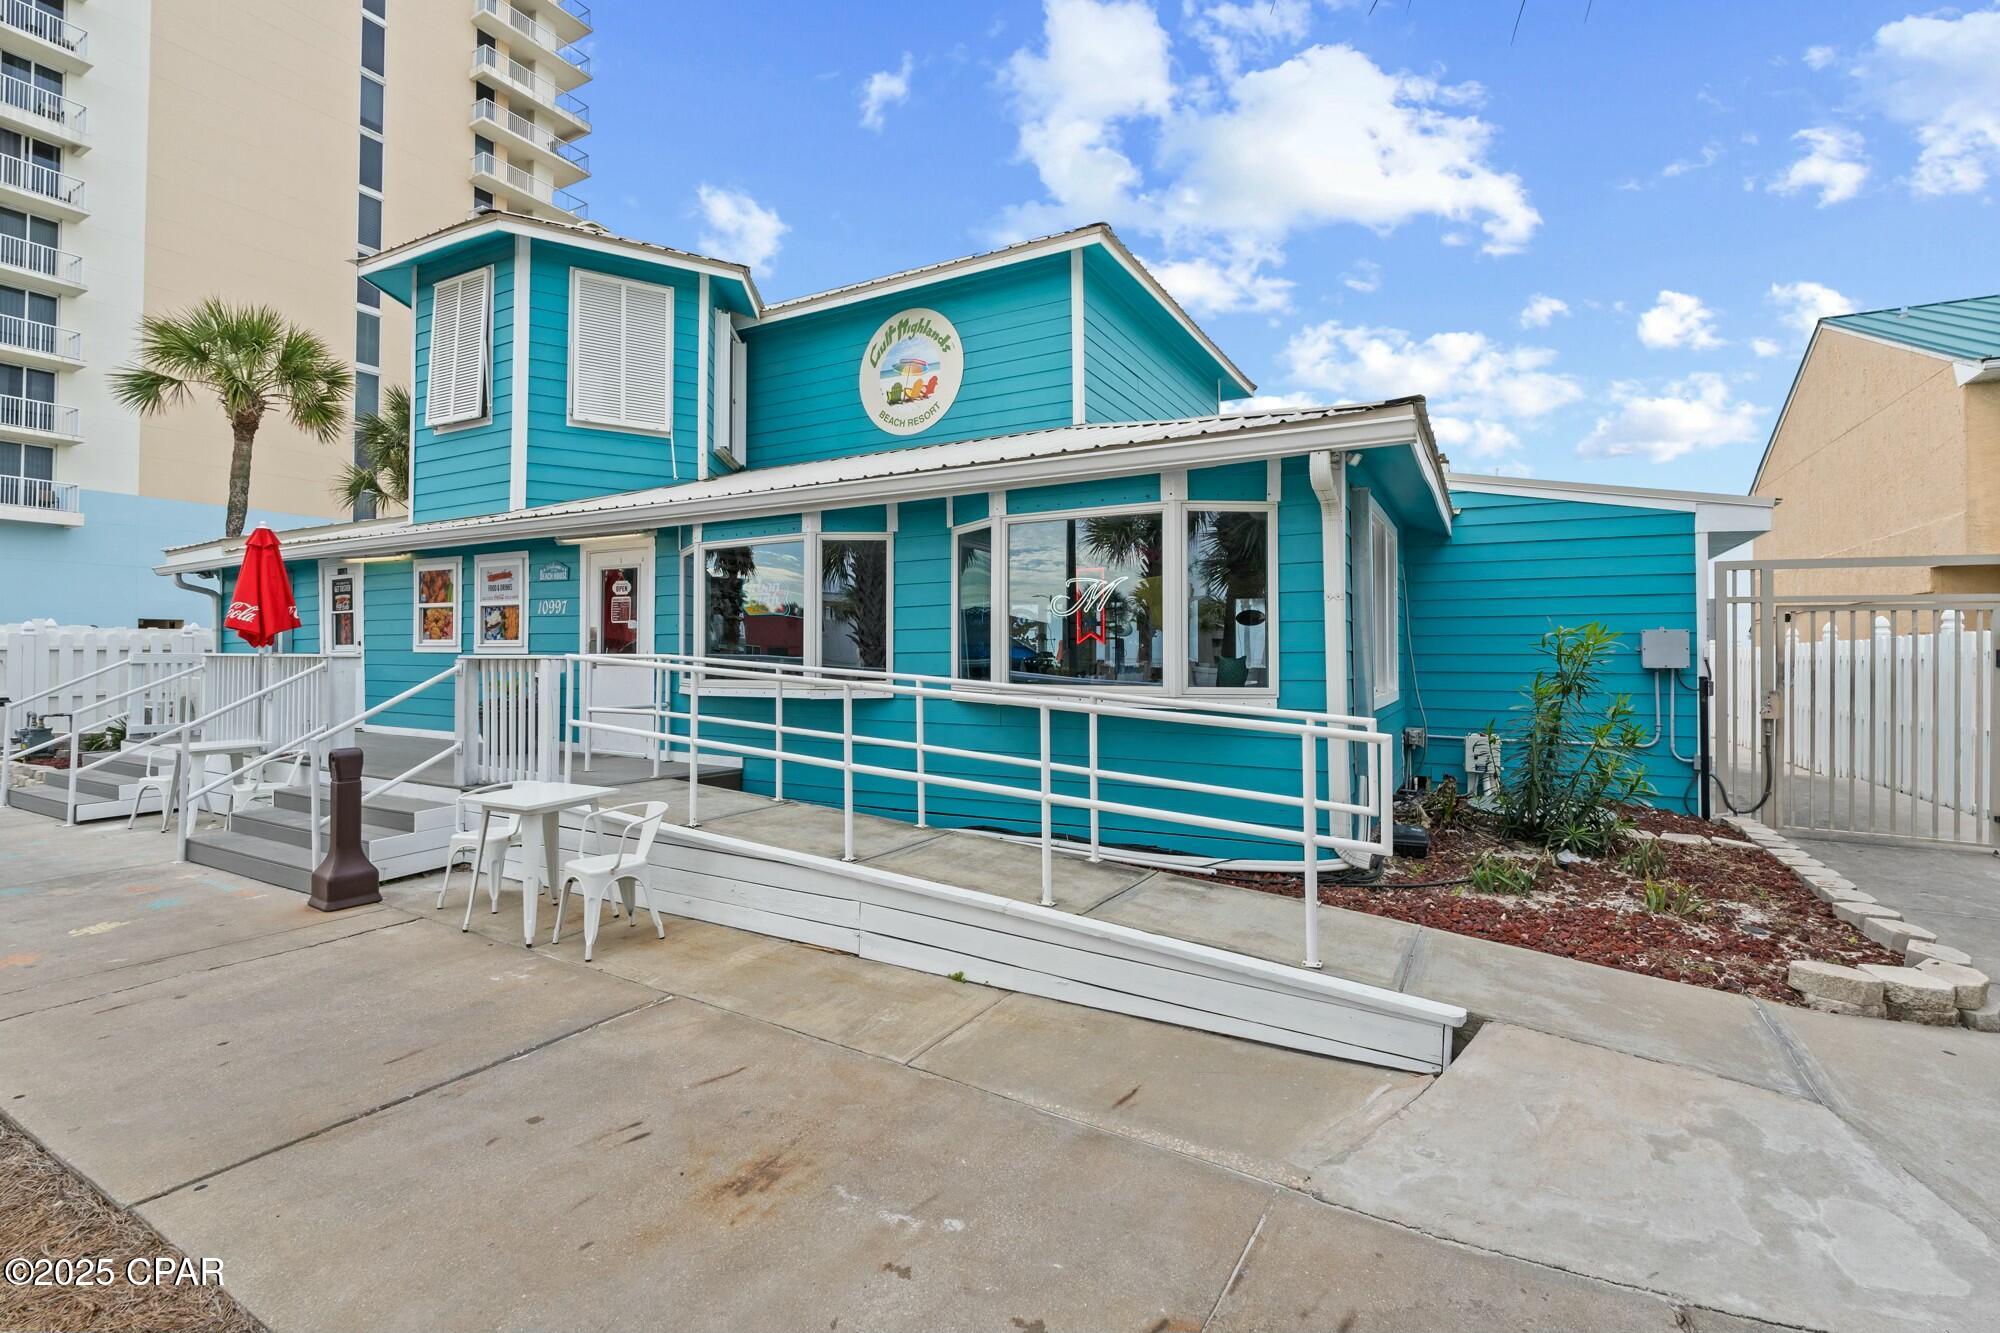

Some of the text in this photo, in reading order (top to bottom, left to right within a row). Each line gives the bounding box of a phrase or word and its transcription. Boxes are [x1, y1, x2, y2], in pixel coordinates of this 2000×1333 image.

[869, 317, 951, 368] Gulf Highlands
[878, 401, 941, 427] BEACH RESORT
[488, 584, 497, 592] FOOD
[500, 583, 512, 591] DRINKS
[538, 599, 568, 615] 10997
